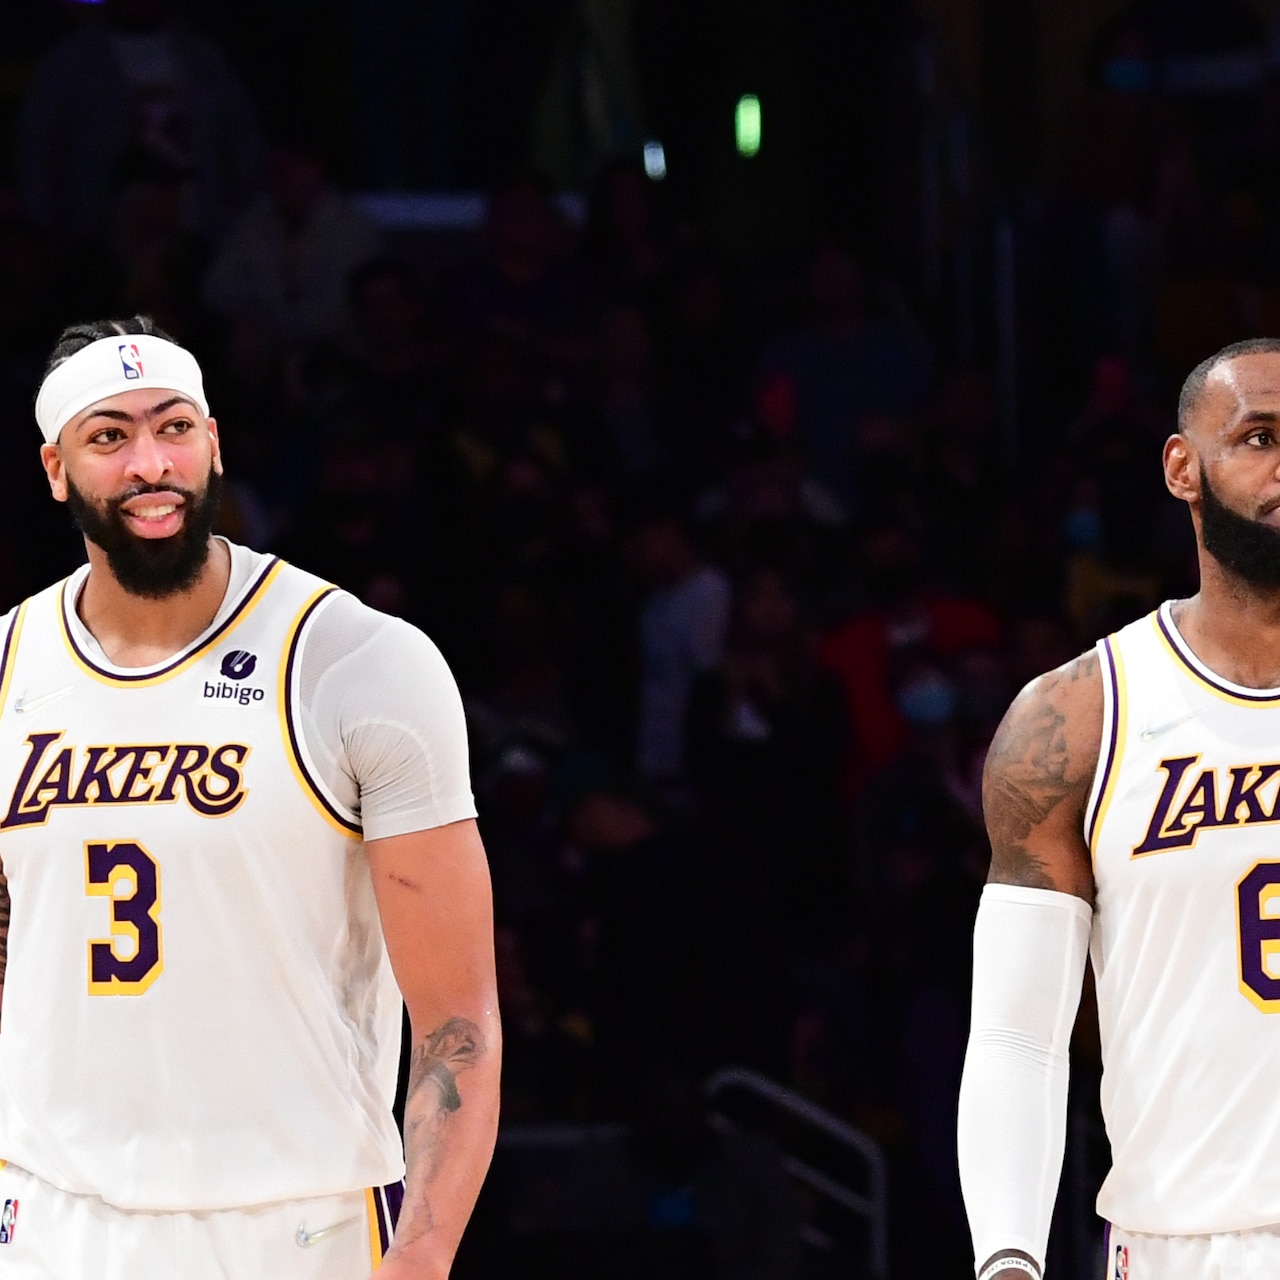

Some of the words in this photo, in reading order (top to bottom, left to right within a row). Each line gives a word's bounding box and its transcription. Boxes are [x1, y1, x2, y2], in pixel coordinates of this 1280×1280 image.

[203, 681, 265, 705] bibigo
[0, 731, 251, 831] LAKERS
[85, 840, 163, 995] 3
